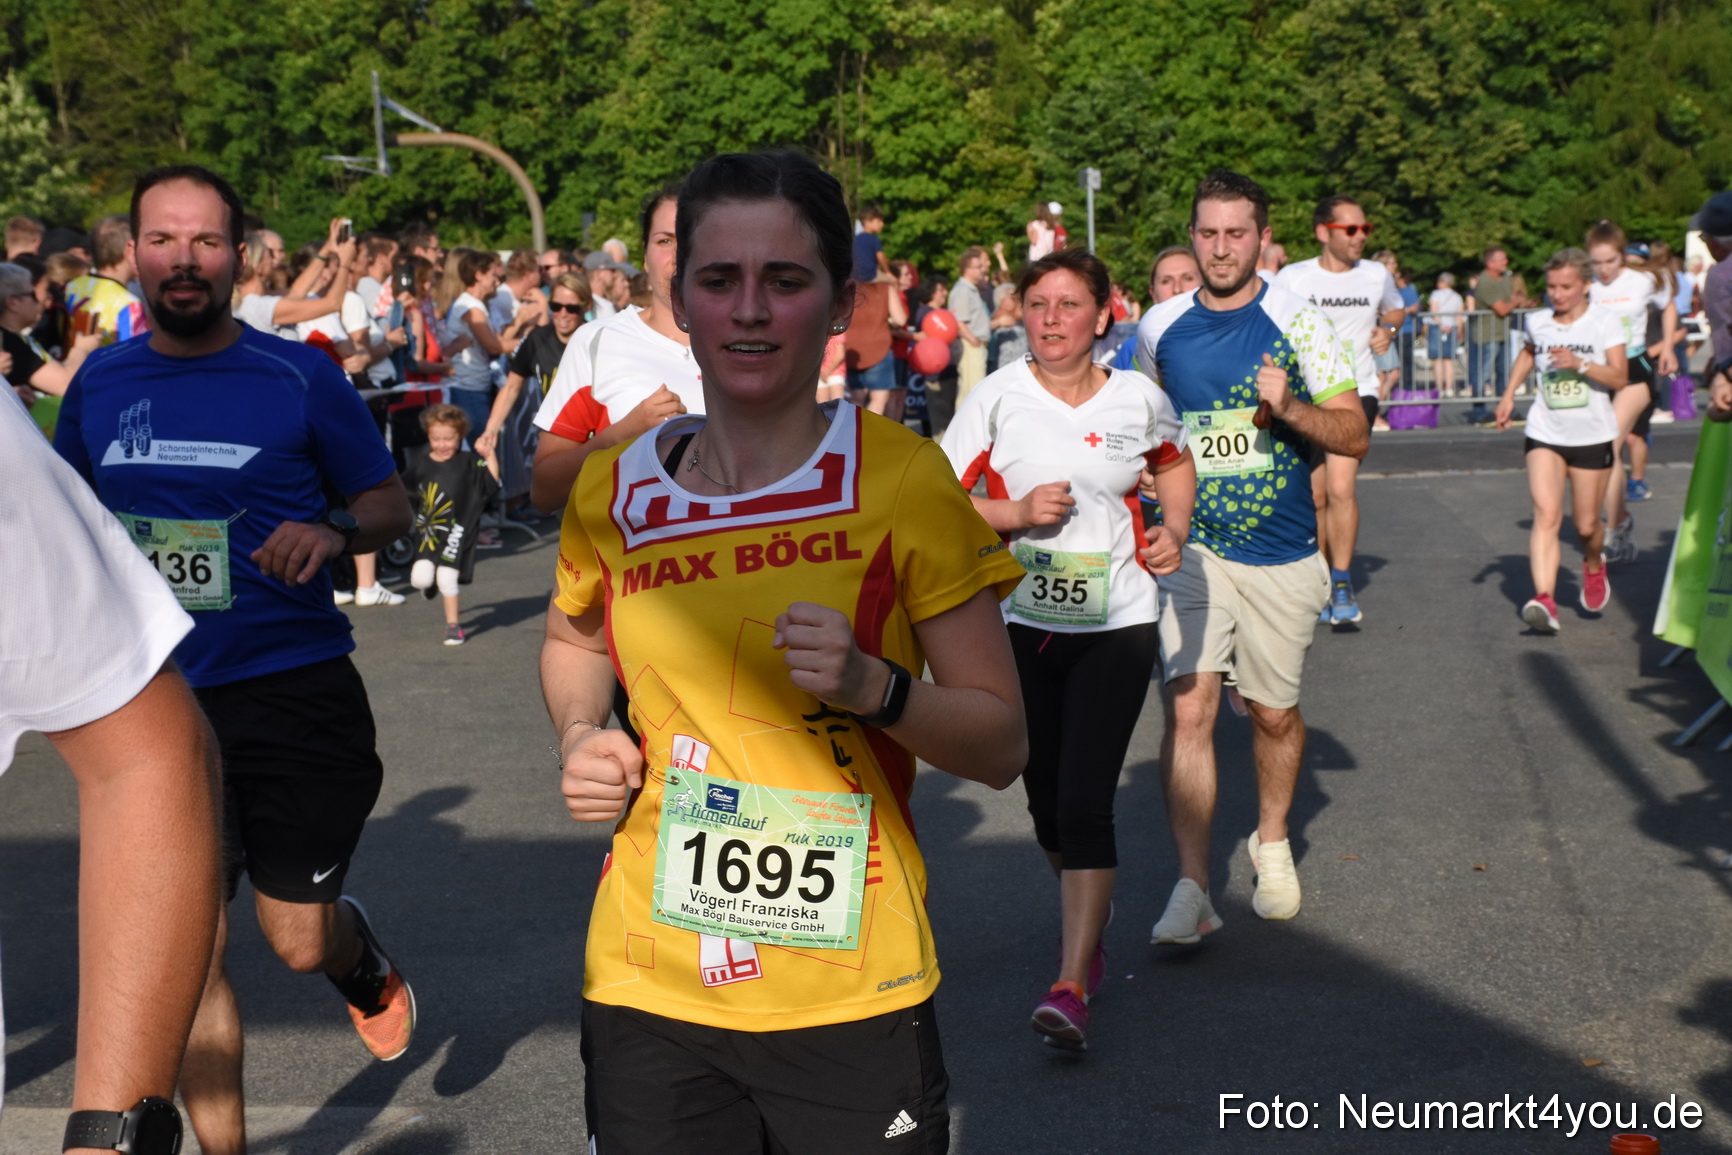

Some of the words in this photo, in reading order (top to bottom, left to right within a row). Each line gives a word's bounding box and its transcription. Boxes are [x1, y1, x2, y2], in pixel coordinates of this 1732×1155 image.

[1321, 297, 1370, 307] MAGNA
[157, 453, 198, 462] Neumarkt
[158, 444, 238, 456] Schornsteintechnik
[1200, 433, 1249, 458] 200
[148, 551, 212, 585] 136
[621, 551, 718, 597] MAX
[734, 531, 863, 575] BÖGL
[1031, 574, 1088, 605] 355
[1033, 601, 1058, 610] Anhalt
[1060, 604, 1084, 613] Galina
[690, 802, 769, 831] firmenlauf
[815, 834, 855, 848] 2019
[683, 831, 836, 904] 1695
[681, 903, 700, 916] Max
[702, 908, 726, 923] Bögl
[729, 914, 788, 930] Bauservice
[791, 922, 825, 933] GmbH
[689, 889, 737, 913] Vögerl
[742, 900, 819, 920] Franziska
[885, 1121, 918, 1139] adidas
